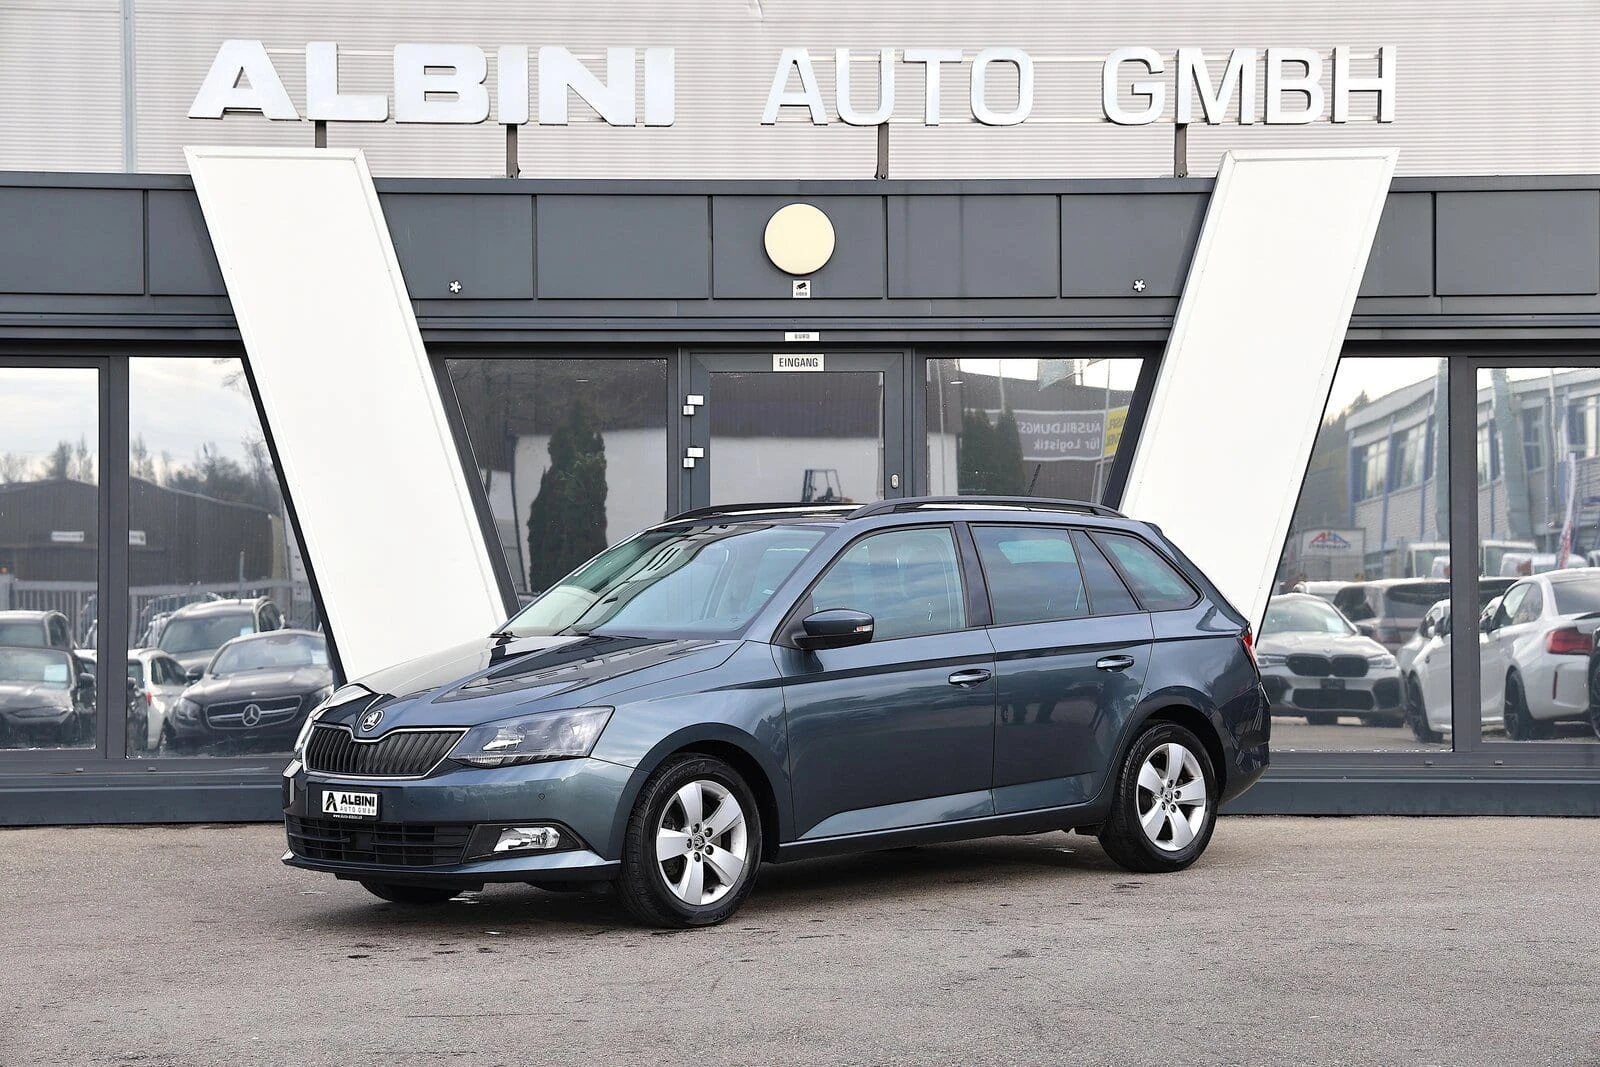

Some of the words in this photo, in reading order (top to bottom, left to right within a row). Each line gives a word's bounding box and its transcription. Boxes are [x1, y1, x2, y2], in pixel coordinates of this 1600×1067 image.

[187, 39, 676, 127] ALBINI
[760, 47, 1035, 127] AUTO
[1100, 46, 1398, 126] GMBH
[779, 357, 819, 368] EINGANG
[340, 794, 375, 807] ALBINI
